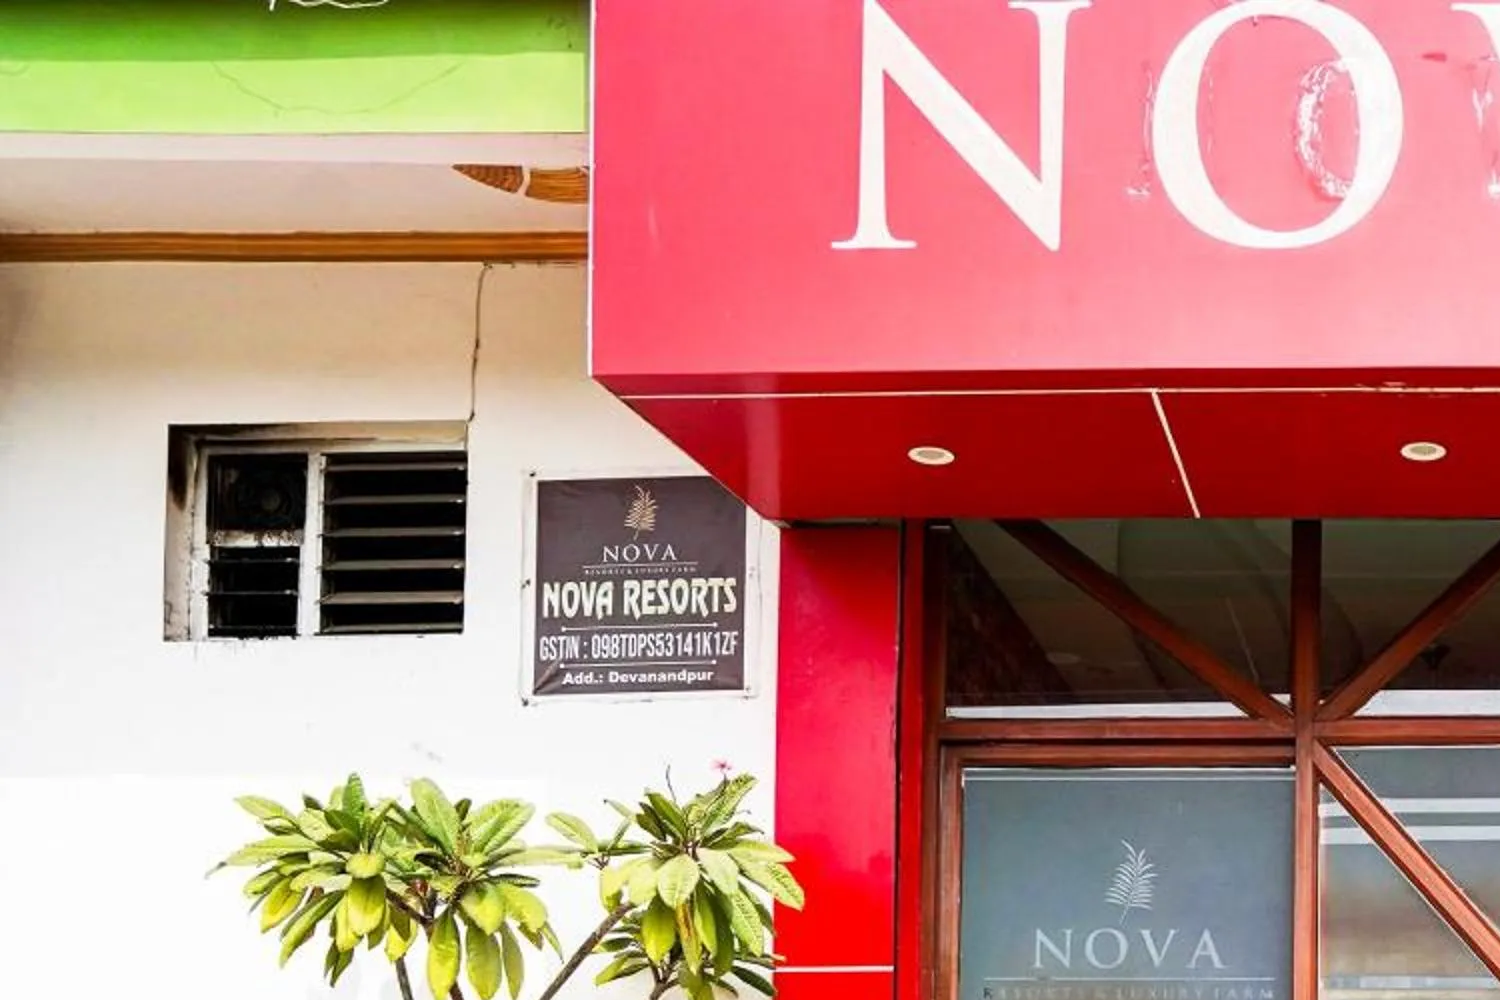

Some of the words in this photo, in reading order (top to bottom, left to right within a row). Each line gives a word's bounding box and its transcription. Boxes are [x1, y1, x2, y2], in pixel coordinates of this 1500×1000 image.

[602, 543, 678, 562] NOVA
[542, 580, 614, 620] NOVA
[623, 577, 738, 620] RESORTS
[540, 635, 580, 660] GSTIN
[608, 669, 715, 685] Devanandpur
[1033, 927, 1229, 970] NOVA
